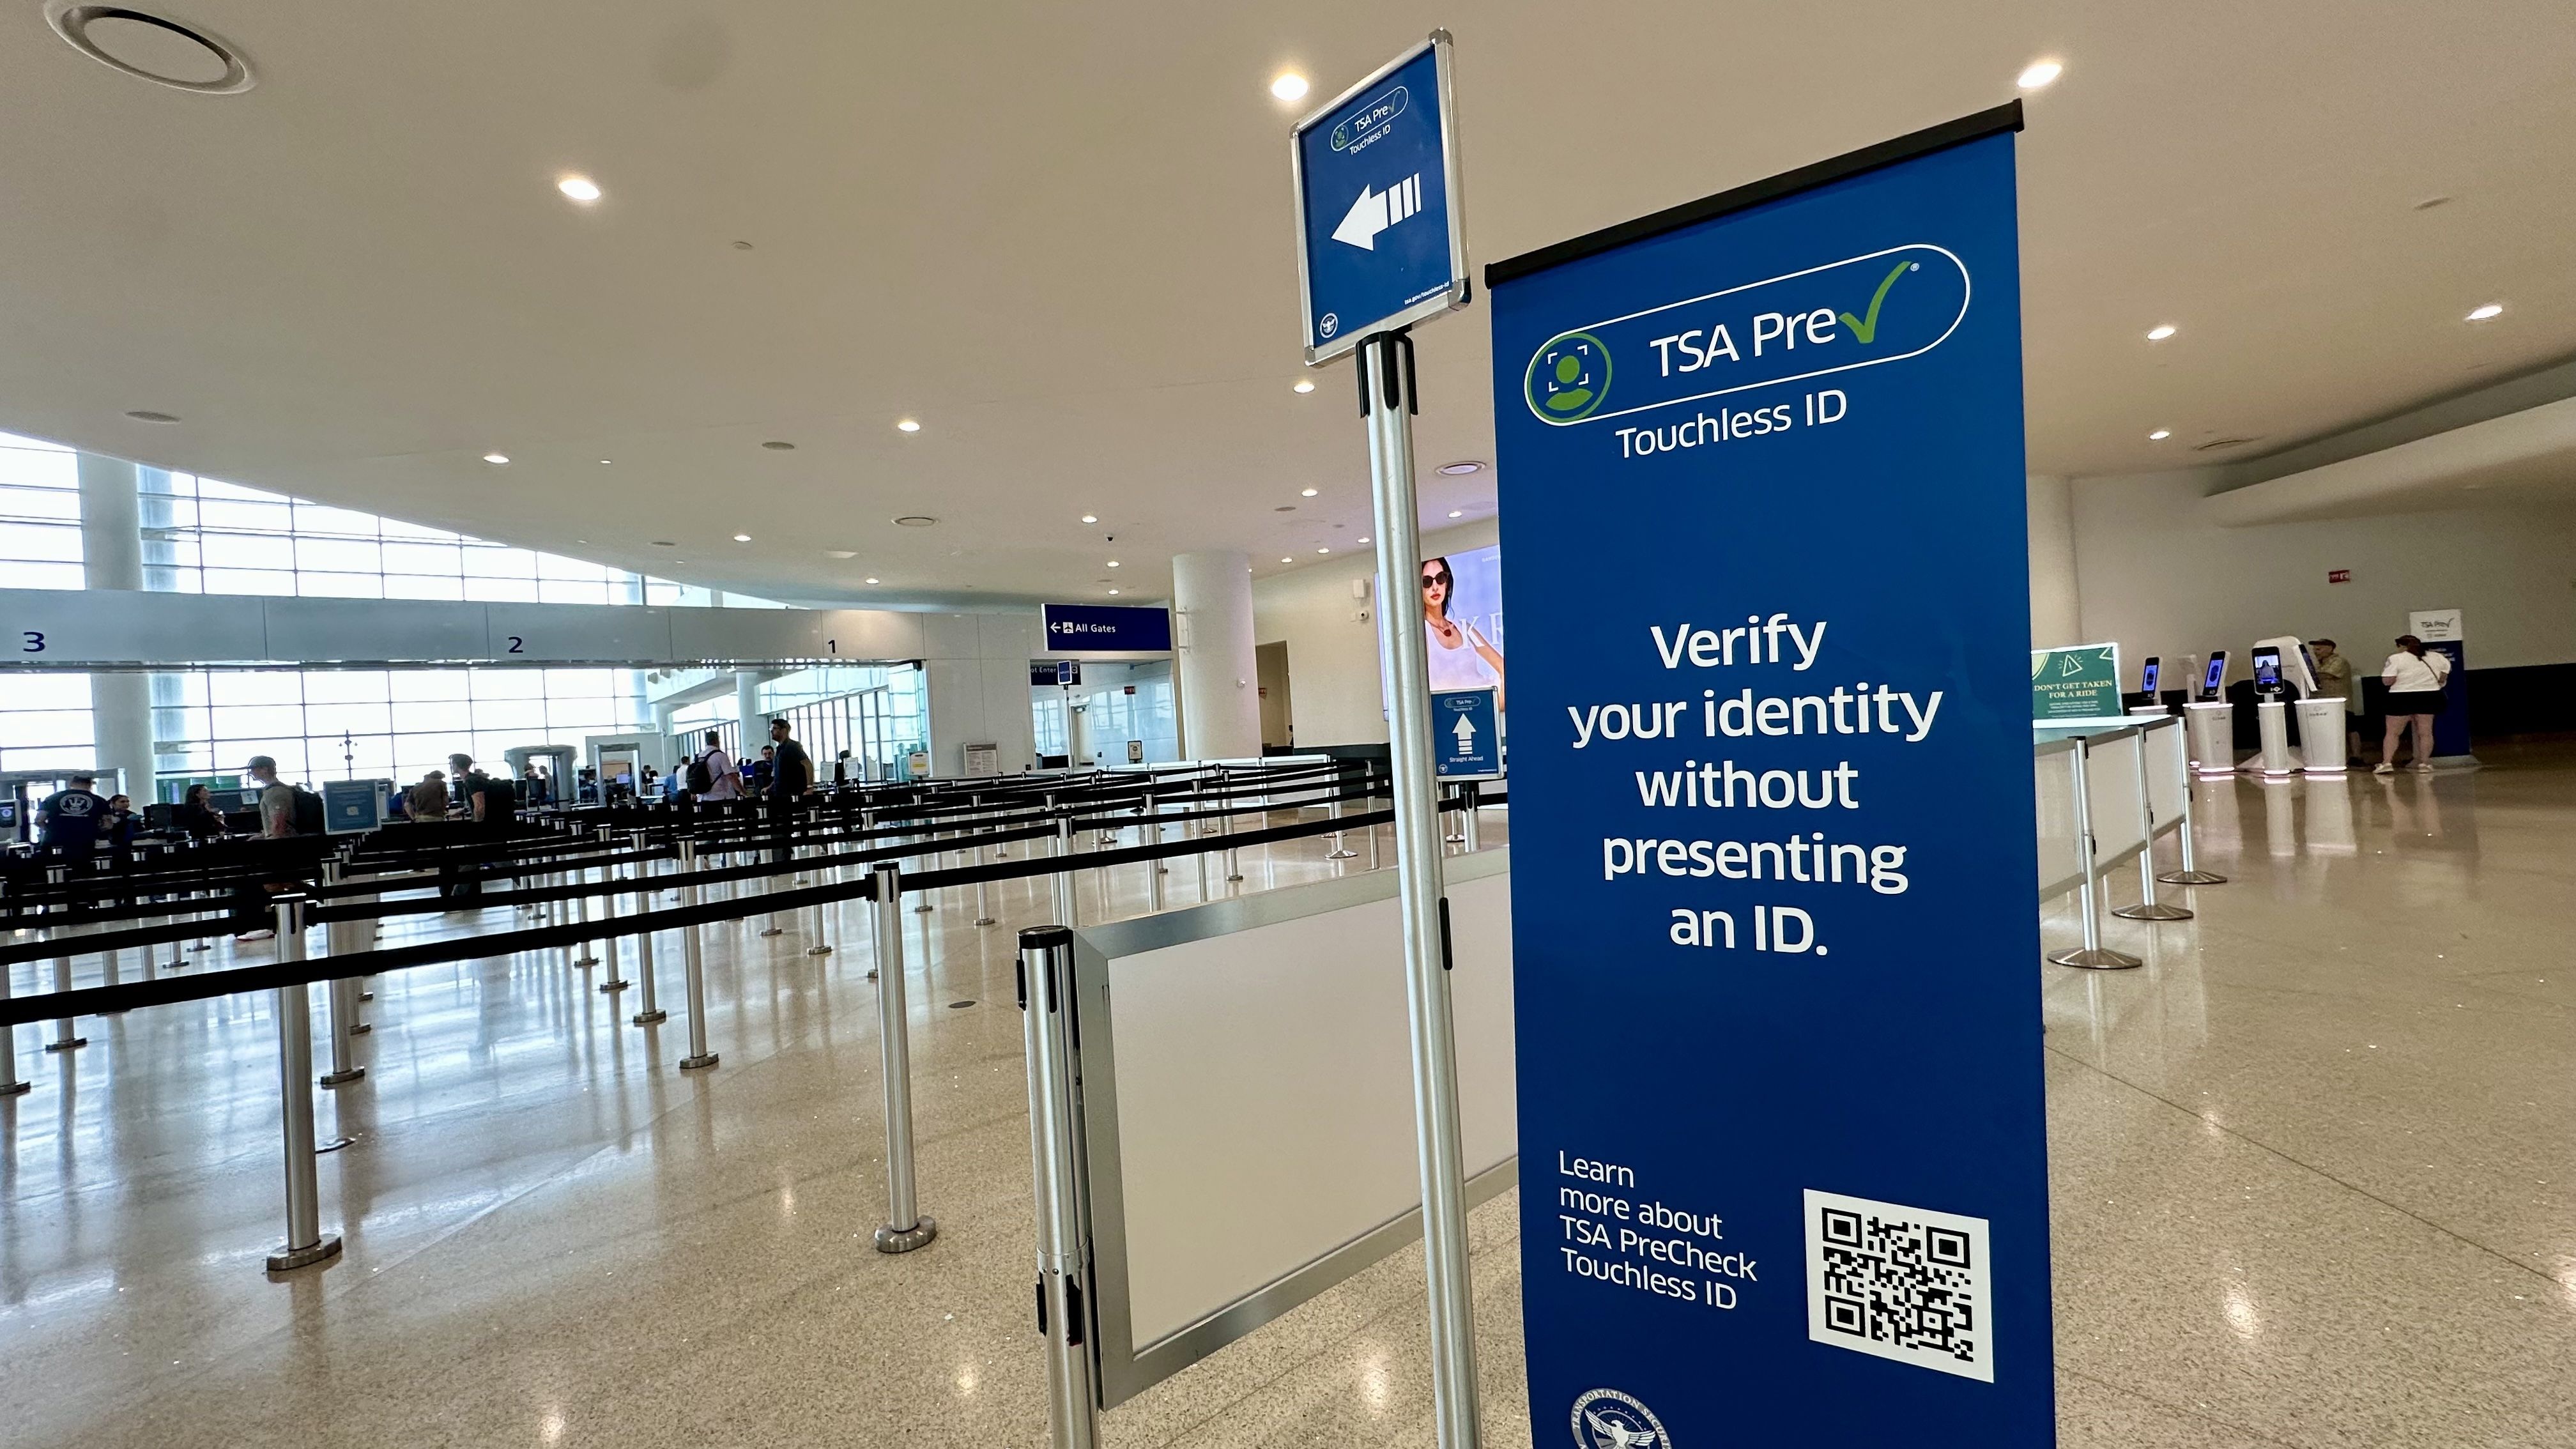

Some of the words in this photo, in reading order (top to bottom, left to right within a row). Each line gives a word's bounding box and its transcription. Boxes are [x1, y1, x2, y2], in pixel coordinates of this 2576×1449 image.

[1349, 130, 1382, 155] Touchless
[1383, 124, 1391, 135] ID
[1354, 115, 1372, 132] TSA
[1373, 105, 1388, 121] Pre
[1650, 324, 1740, 377] TSA
[1753, 307, 1836, 356] Pre
[1616, 403, 1791, 458] Touchless
[1806, 390, 1847, 426] ID
[24, 632, 45, 652] 3
[509, 636, 523, 653] 2
[828, 640, 836, 654] 1
[1075, 624, 1087, 632] All
[1091, 624, 1116, 632] Gates
[1650, 613, 1827, 671] Verify
[2082, 680, 2112, 688] TAKEN
[1568, 701, 1687, 749] your
[1703, 682, 1943, 742] identity
[1636, 760, 1859, 809] without
[1604, 832, 1908, 894] presenting
[1670, 908, 1735, 949] an
[1755, 905, 1828, 956] ID.
[1559, 1150, 1634, 1188] Learn
[1560, 1187, 1630, 1220] more
[1639, 1201, 1723, 1239] about
[1560, 1215, 1612, 1249] TSA
[1620, 1228, 1758, 1281] PreCheck
[1561, 1247, 1696, 1301] Touchless
[1706, 1281, 1736, 1309] ID
[1572, 1389, 1639, 1429] TRANSPORTATION
